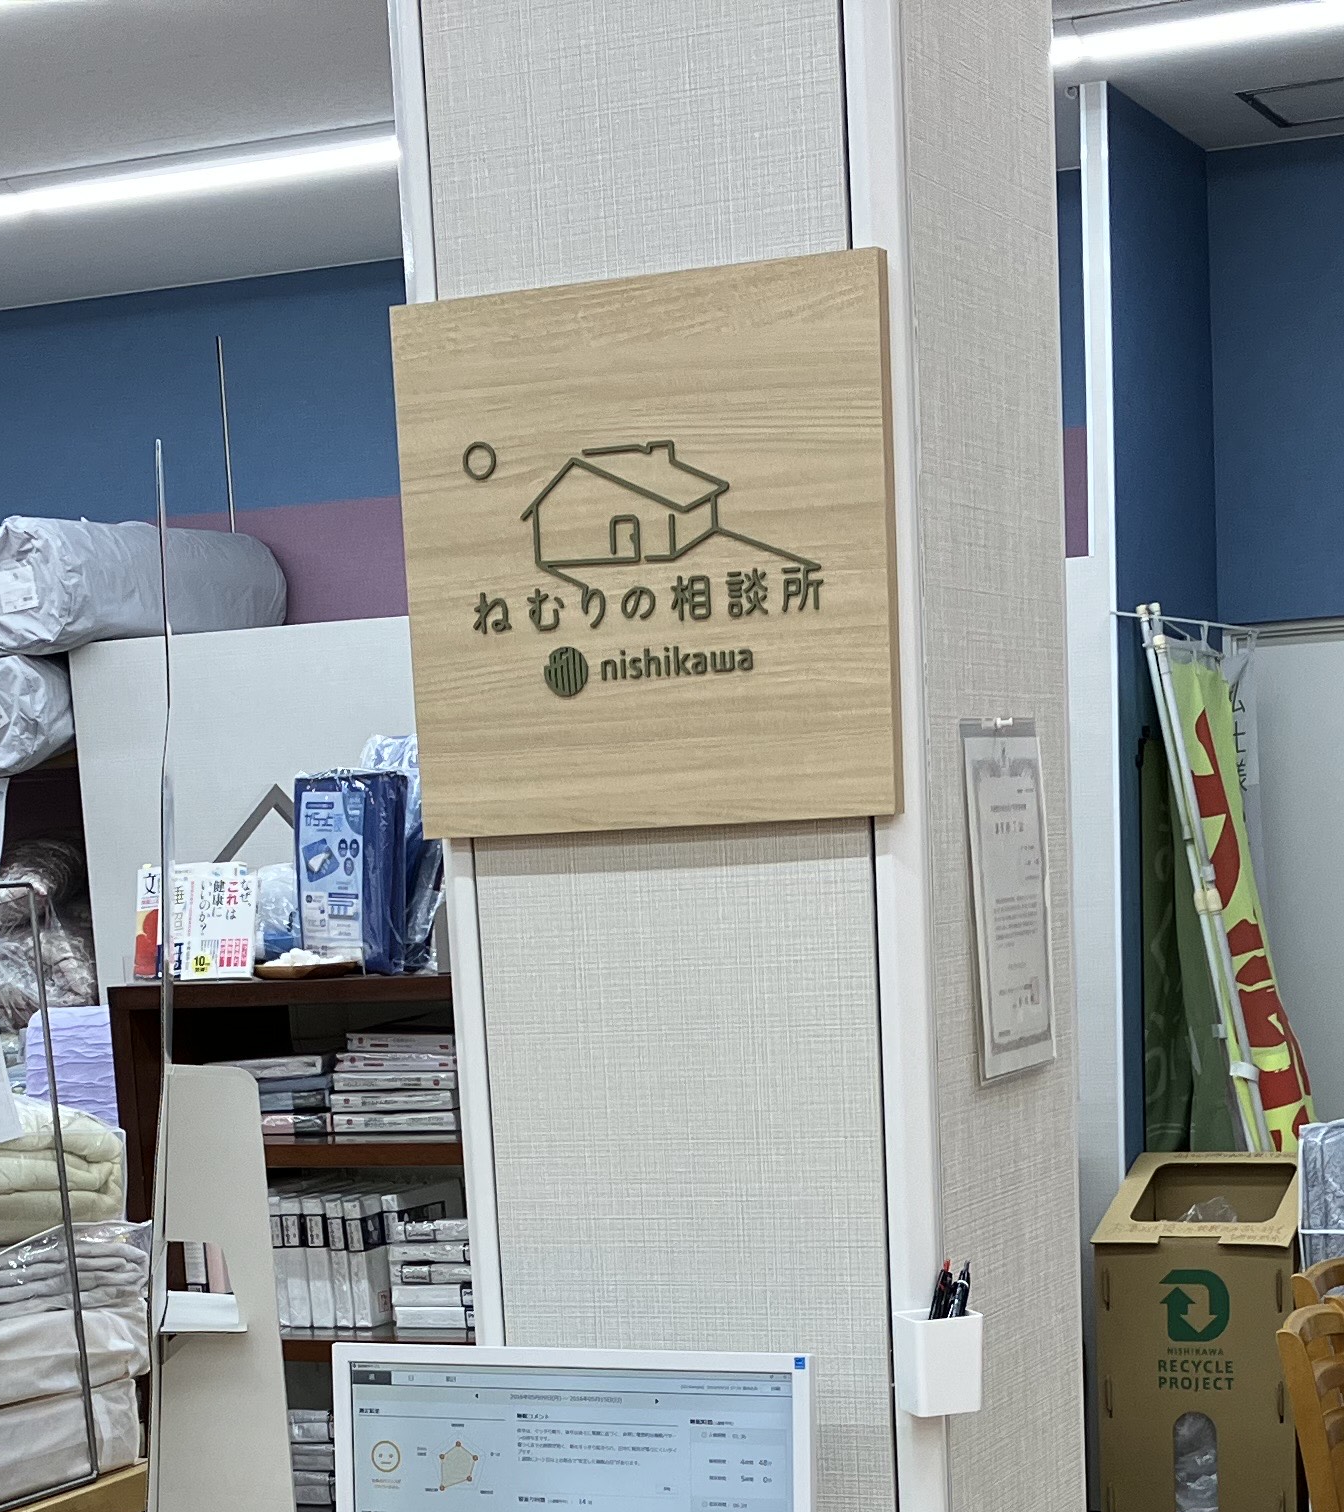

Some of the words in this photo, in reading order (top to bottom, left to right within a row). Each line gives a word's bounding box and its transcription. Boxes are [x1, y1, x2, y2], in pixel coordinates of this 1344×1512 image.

[472, 567, 824, 634] ねむりの相談所
[600, 645, 754, 682] nishikawa
[1167, 1347, 1225, 1356] NISHIKAWA
[1158, 1359, 1234, 1374] RECYCLE
[1158, 1376, 1234, 1392] PROJECT
